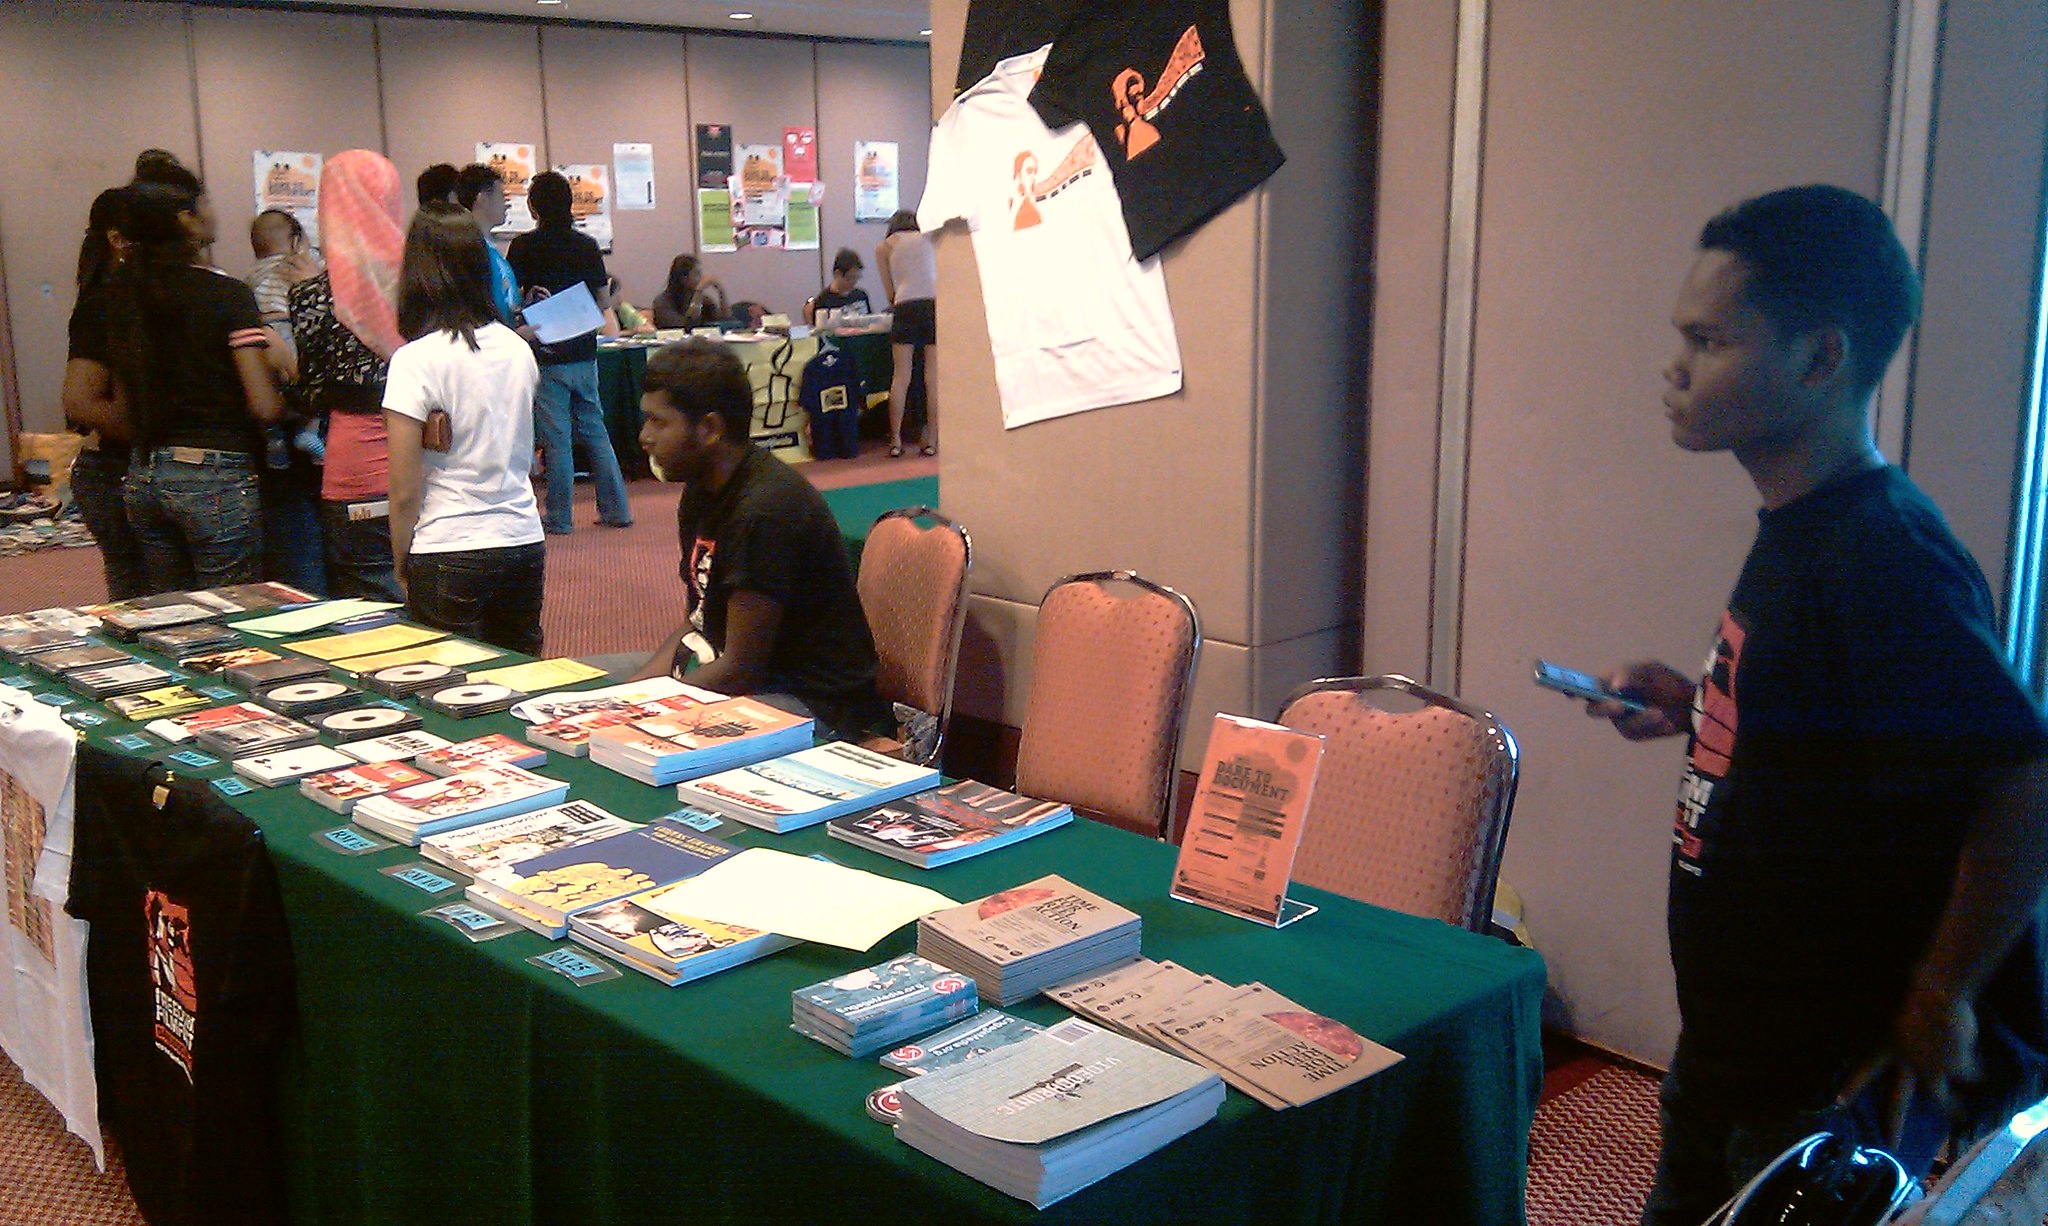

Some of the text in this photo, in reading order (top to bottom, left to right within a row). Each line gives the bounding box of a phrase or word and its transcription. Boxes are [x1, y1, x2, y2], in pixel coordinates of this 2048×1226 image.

[1216, 761, 1273, 783] DARE TO
[1213, 772, 1289, 801] DOCUMENT
[1054, 898, 1082, 911] FOR
[1066, 894, 1100, 912] TIME
[1031, 906, 1082, 930] ACTION
[836, 982, 925, 1014] EngageMedia.org
[932, 1017, 1016, 1057] EngageMedia.org
[1250, 1041, 1309, 1070] ACTION
[1300, 1054, 1335, 1070] FOR
[1303, 1063, 1349, 1082] TIME
